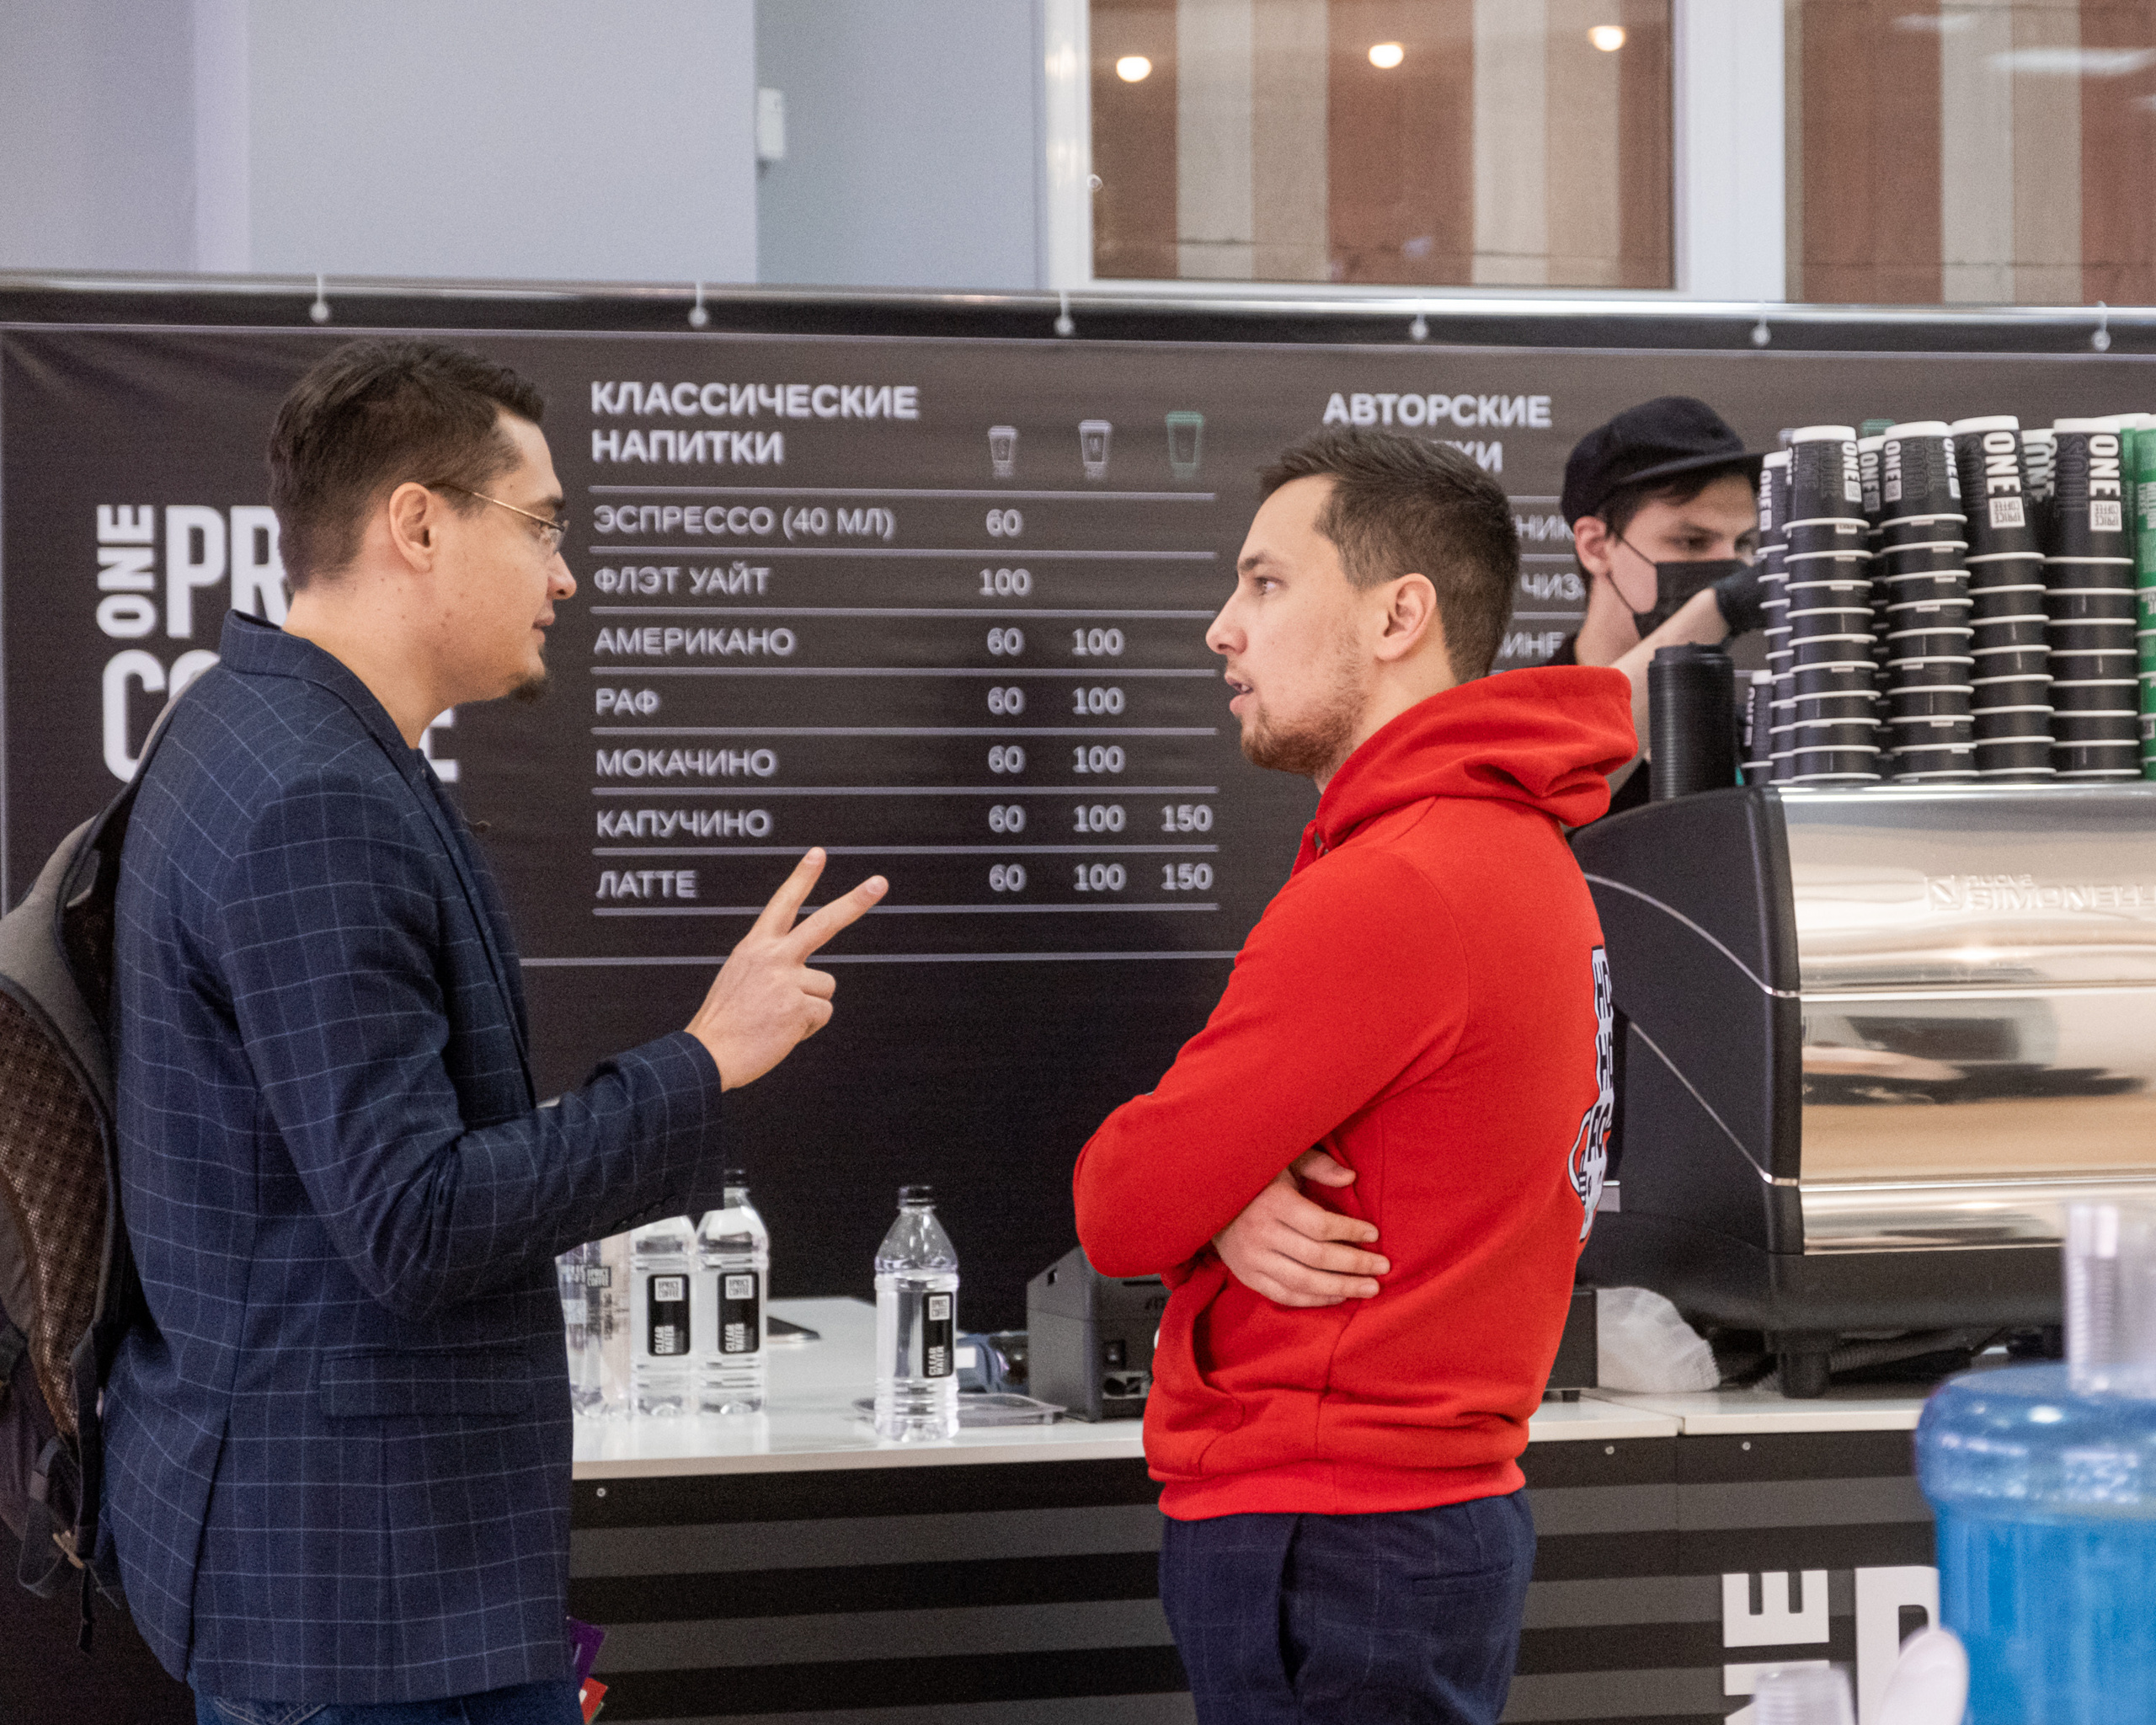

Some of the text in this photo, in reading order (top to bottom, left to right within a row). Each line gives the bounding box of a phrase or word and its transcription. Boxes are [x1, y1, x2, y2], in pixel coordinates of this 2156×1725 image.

[591, 382, 920, 421] КЛАССИЧЕСКИЕ
[1322, 393, 1553, 429] АВТОРСКИЕ
[591, 430, 784, 466] НАПИТКИ
[1842, 441, 1860, 482] ONE
[1885, 441, 1902, 482] ONE
[1943, 438, 1959, 478] ONE
[1983, 431, 2021, 494] ONE
[2089, 435, 2121, 497] ONE
[1860, 452, 1880, 493] ONE
[594, 505, 1024, 541] ЭСПРЕССО (40 МЛ) 60
[96, 505, 157, 638] ONE
[594, 562, 1033, 597] ФЛЭТ УАЙТ 100
[594, 628, 1125, 657] АМЕРИКАНО 60 100
[595, 686, 1126, 717] РАФ 60 100
[596, 745, 1127, 777] МОКАЧИНО 60 100
[596, 804, 1214, 838] КАПУЧИНО 60 100 150
[595, 863, 1214, 900] ЛАТТЕ 60 100 150
[1968, 885, 2156, 911] SIMONELL
